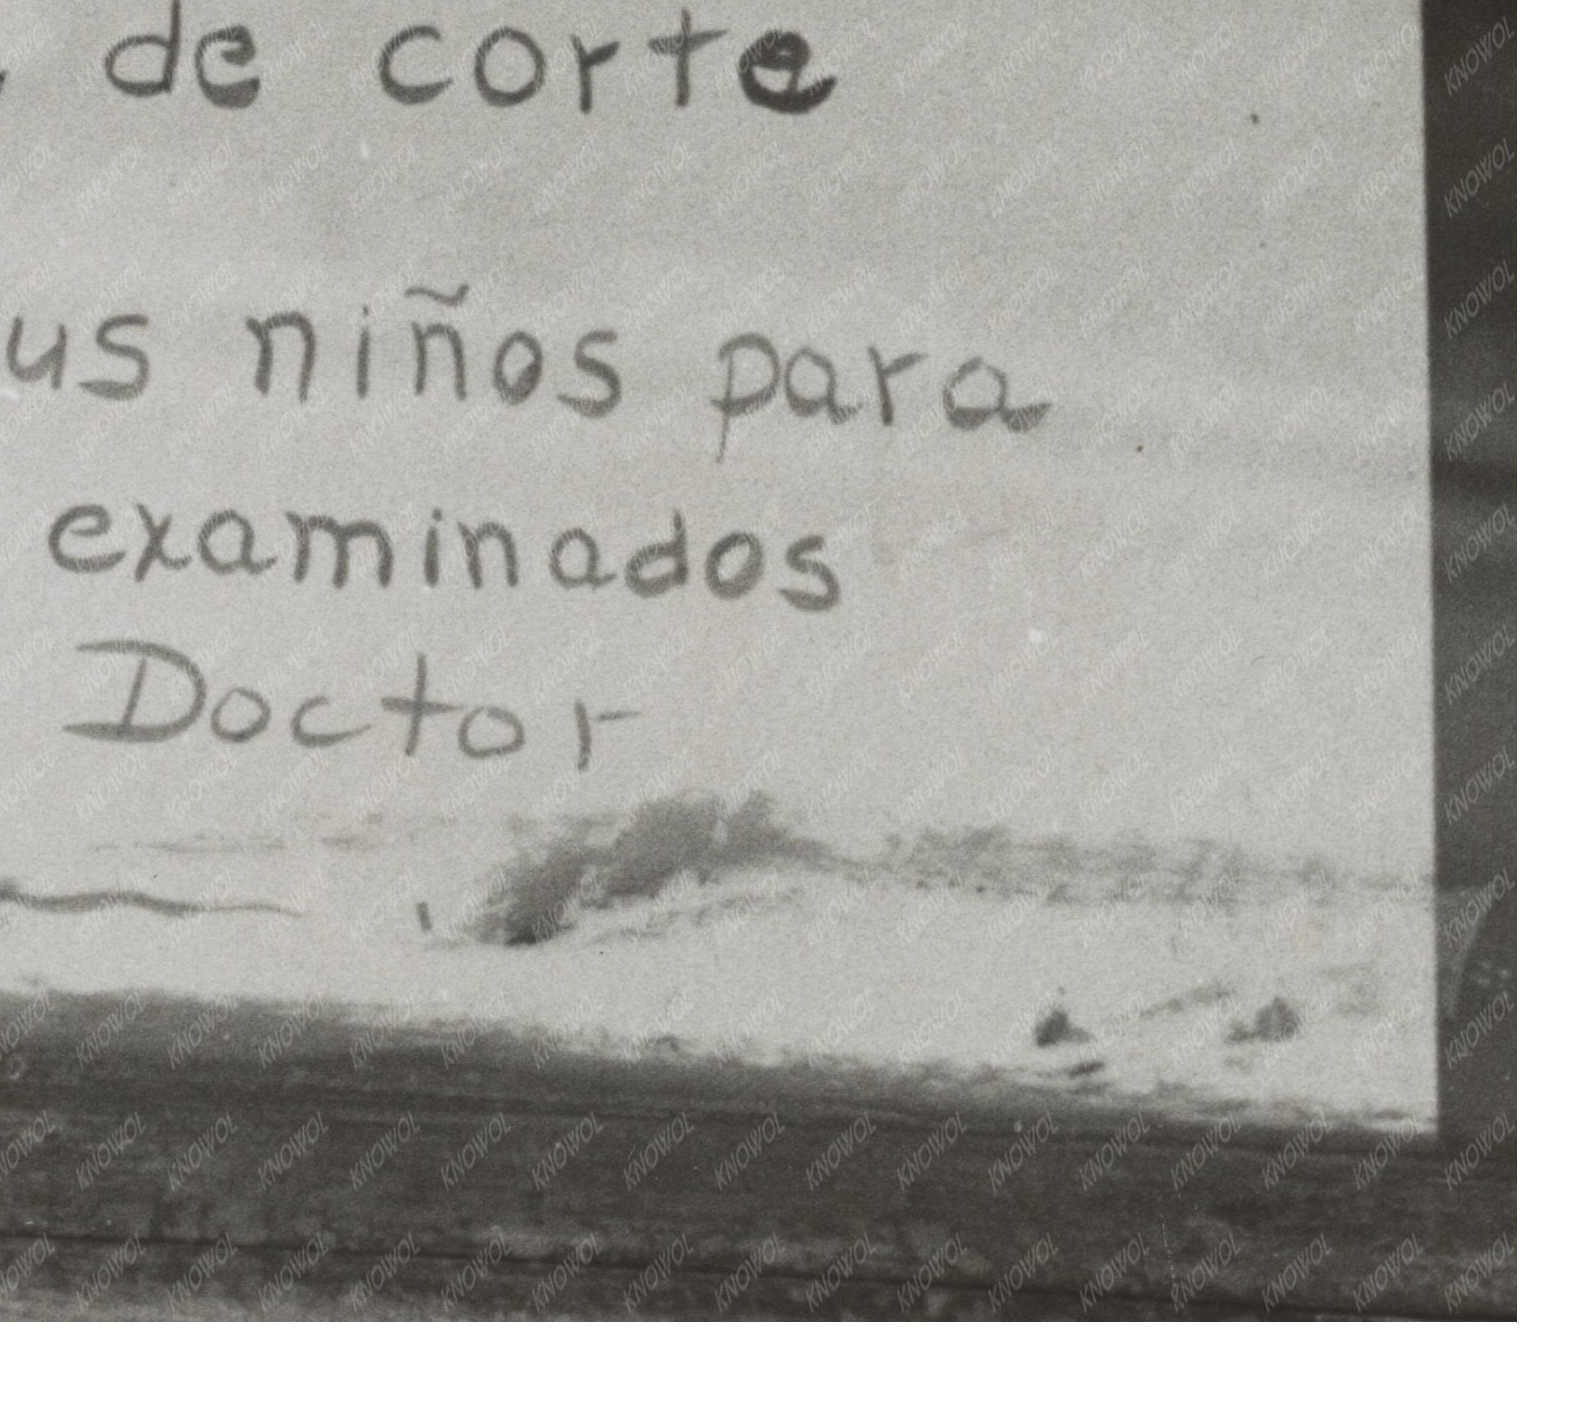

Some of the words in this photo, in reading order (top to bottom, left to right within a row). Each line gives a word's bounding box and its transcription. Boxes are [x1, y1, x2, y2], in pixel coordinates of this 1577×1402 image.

[377, 12, 838, 117] corte
[242, 282, 621, 420] niños
[709, 330, 1052, 459] para
[44, 501, 843, 615] examinados
[63, 637, 639, 772] Doctor
